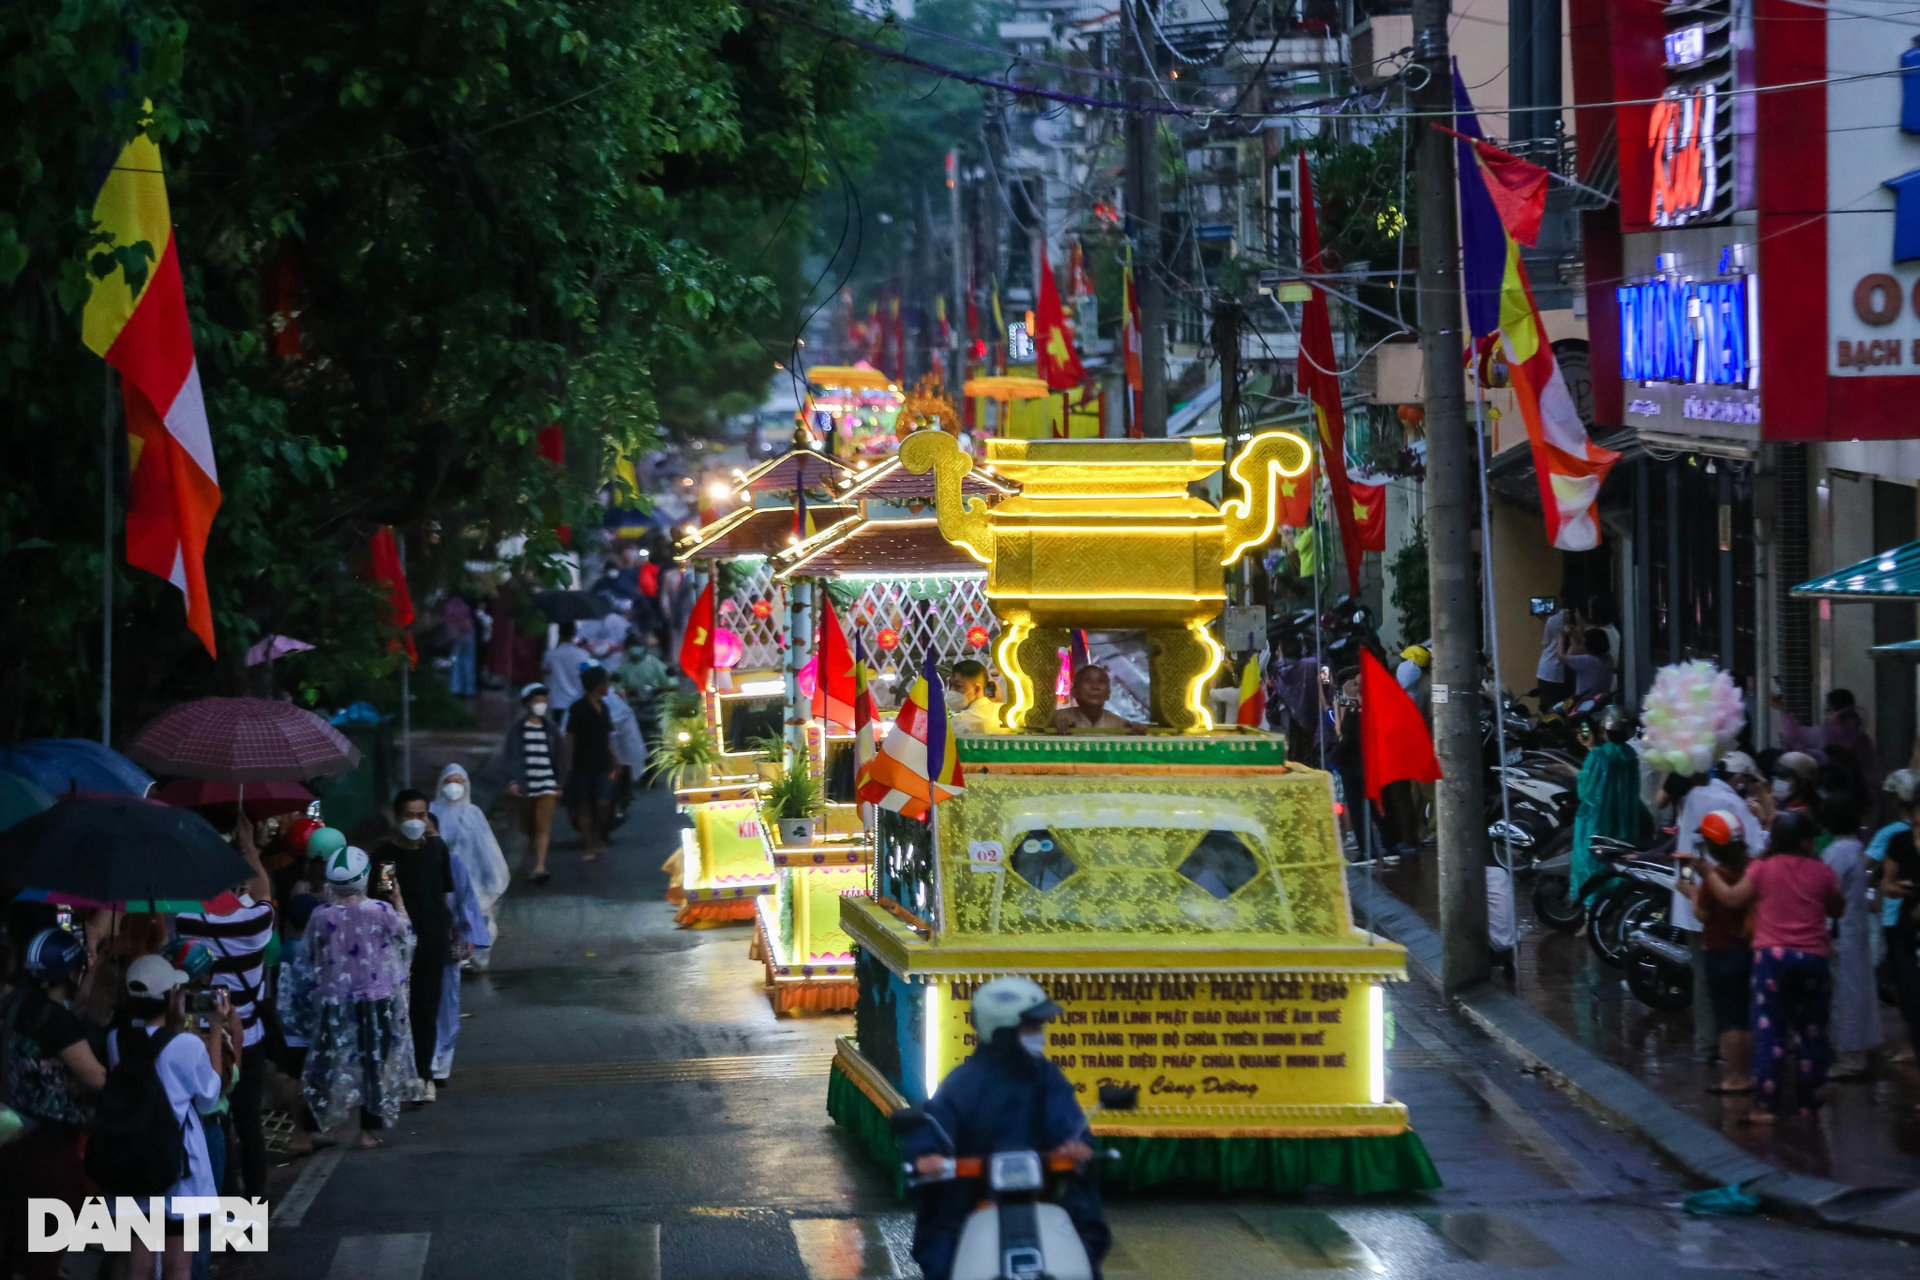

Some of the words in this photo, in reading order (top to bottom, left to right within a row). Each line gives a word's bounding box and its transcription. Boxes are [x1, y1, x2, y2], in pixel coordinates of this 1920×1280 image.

[1838, 339, 1902, 372] BẠCH
[977, 849, 998, 863] 02
[1061, 1011, 1087, 1027] LỊCH
[1092, 1008, 1119, 1024] TÂM
[1124, 1011, 1151, 1024] LINH
[1156, 1008, 1188, 1026] PHẬT
[1192, 1008, 1222, 1024] GIÁO
[1081, 1030, 1124, 1046] TRÀNG
[1128, 1033, 1157, 1049] TỊNH
[1184, 1030, 1218, 1046] CHÙA
[1081, 1052, 1124, 1068] TRÀNG
[1129, 1052, 1157, 1070] DIỆU
[1162, 1052, 1197, 1068] PHÁP
[1201, 1051, 1235, 1068] CHÙA
[1239, 1055, 1282, 1069] QUANG
